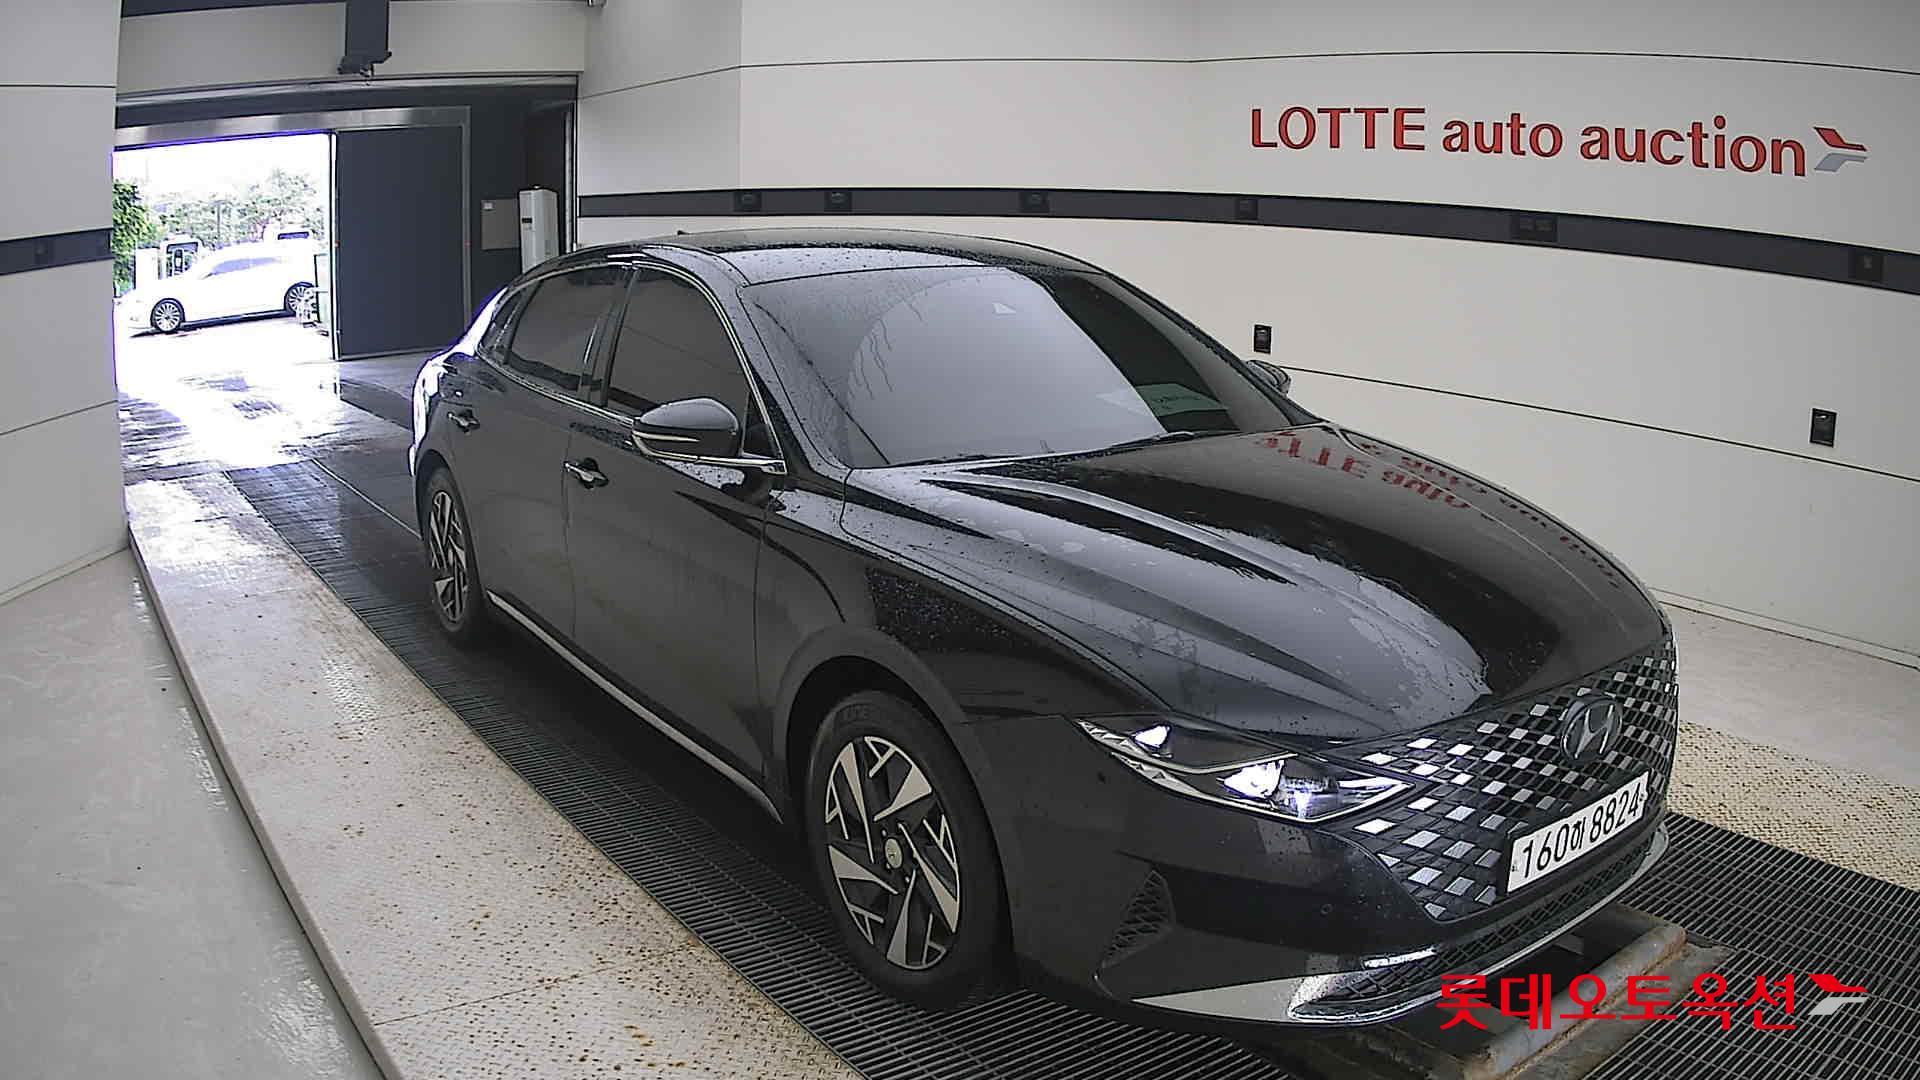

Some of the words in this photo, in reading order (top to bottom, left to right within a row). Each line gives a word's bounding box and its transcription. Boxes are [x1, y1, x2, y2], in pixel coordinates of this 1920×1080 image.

[1252, 107, 1426, 151] LOTTE
[1442, 112, 1564, 158] auto
[1580, 115, 1807, 177] auction
[1590, 782, 1642, 844] 8824
